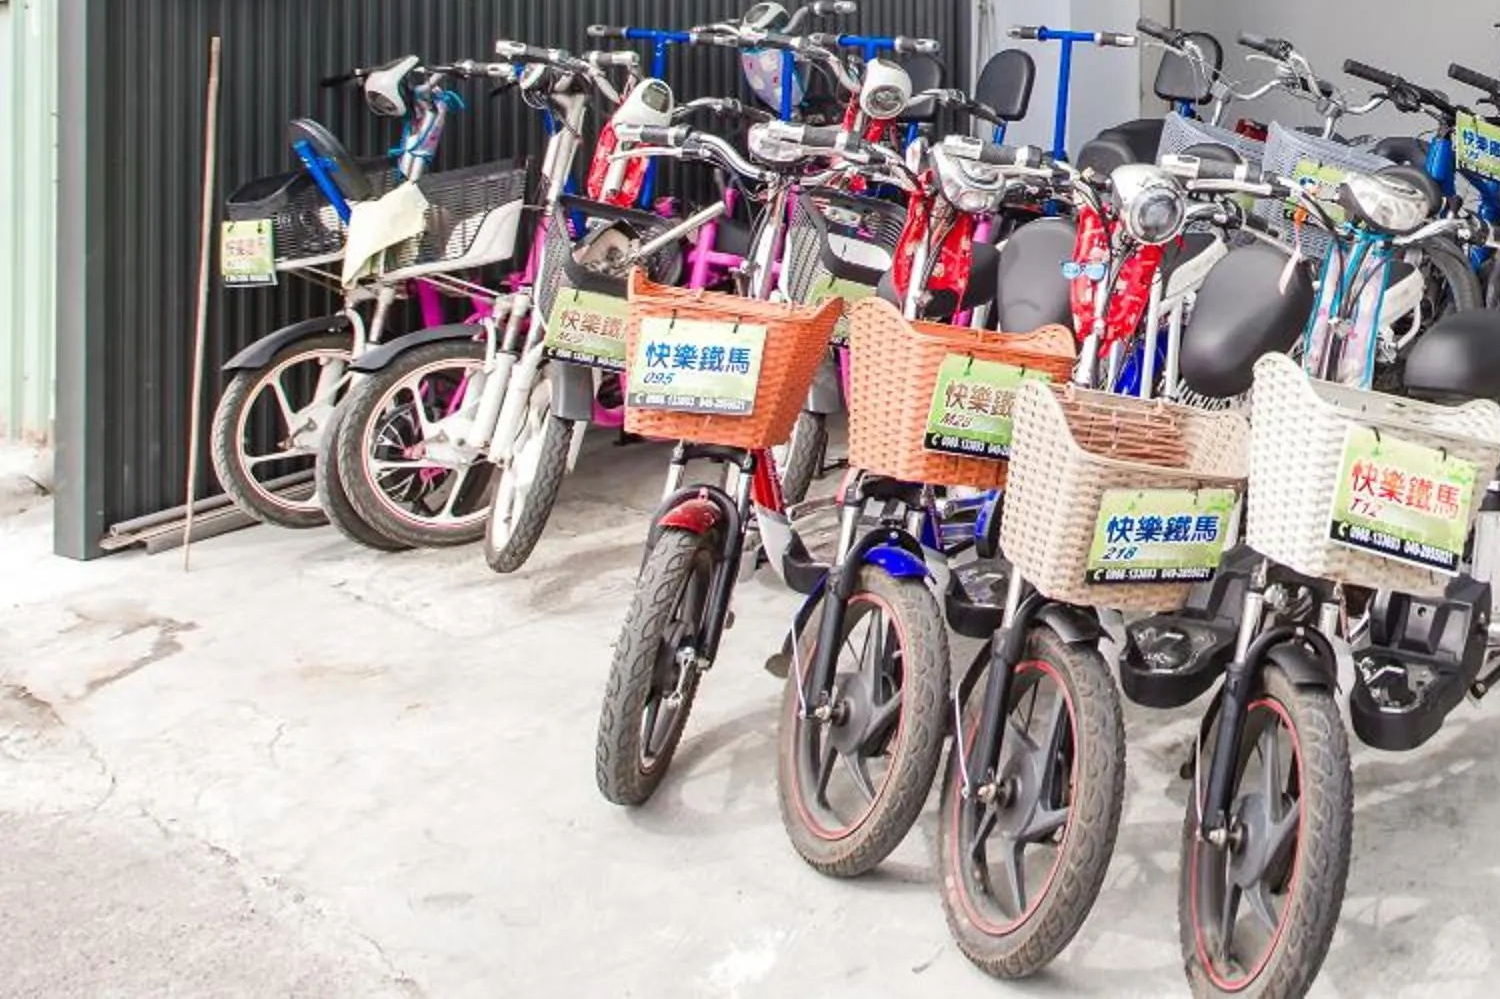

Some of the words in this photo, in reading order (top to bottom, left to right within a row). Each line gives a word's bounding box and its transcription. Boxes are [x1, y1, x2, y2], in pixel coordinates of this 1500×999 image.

[561, 309, 625, 339] 快樂鐵
[645, 340, 751, 374] 快樂鐵馬
[643, 372, 675, 385] 095
[945, 380, 1017, 417] 快樂鐵
[1352, 460, 1461, 519] 快樂鐵馬
[1106, 514, 1219, 543] 快樂鐵馬
[1102, 546, 1138, 560] 218
